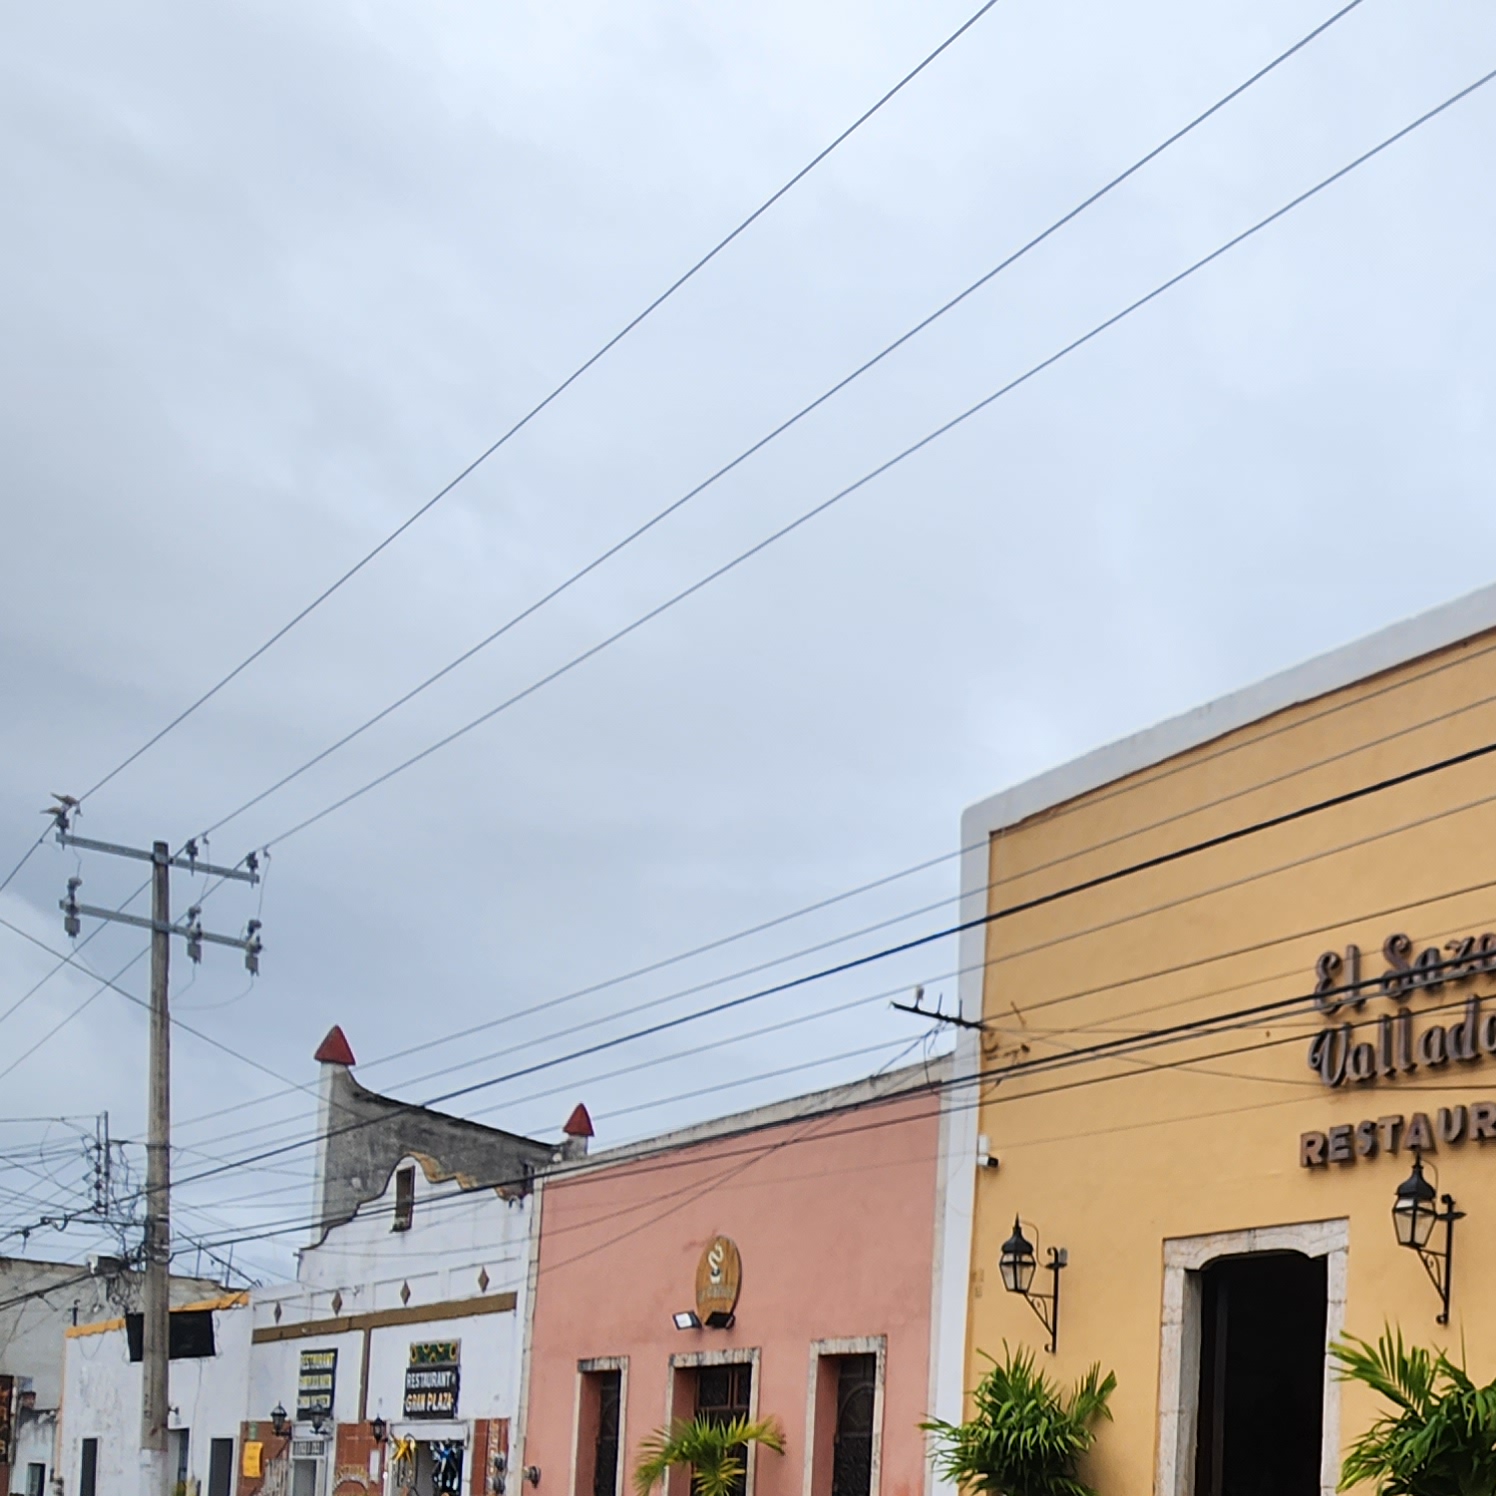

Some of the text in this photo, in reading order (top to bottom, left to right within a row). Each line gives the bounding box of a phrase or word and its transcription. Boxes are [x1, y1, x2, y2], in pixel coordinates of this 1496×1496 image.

[1314, 944, 1365, 1015] El
[406, 1371, 451, 1389] RESTAURANT
[405, 1392, 453, 1412] GRAN PLAZA
